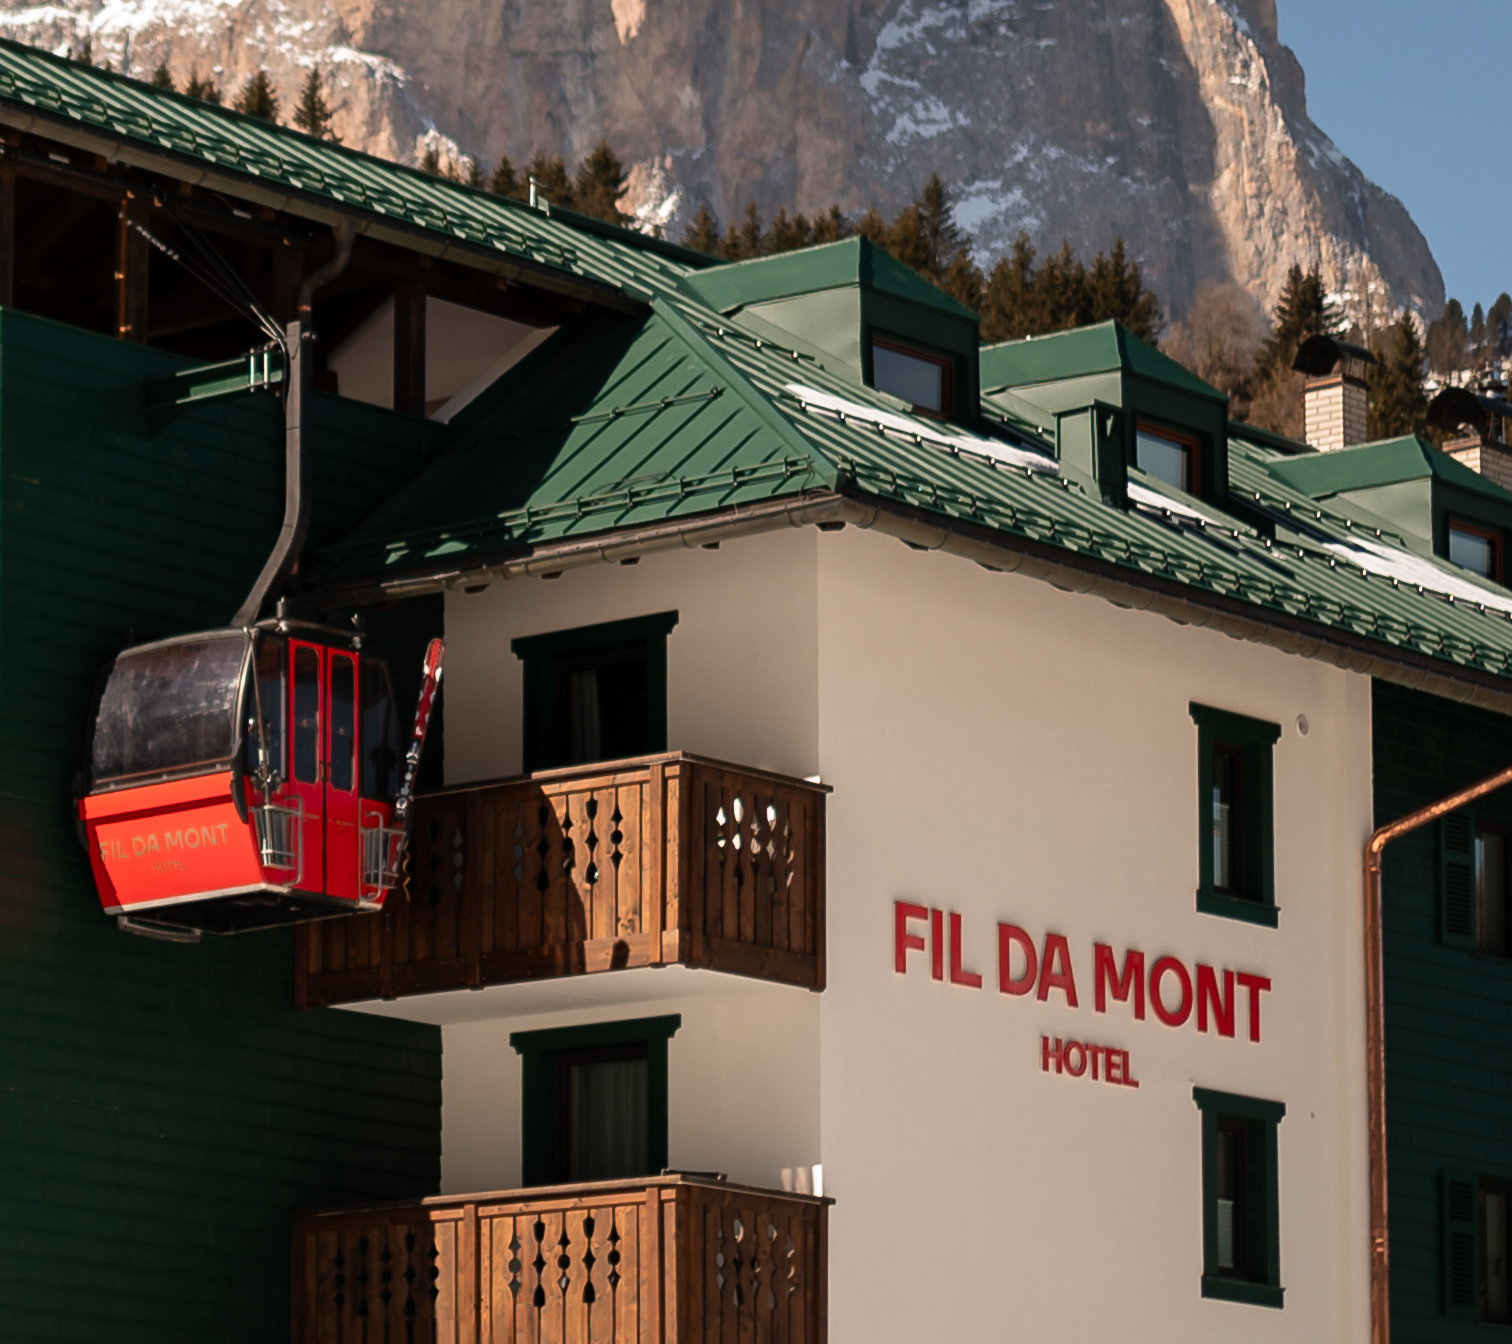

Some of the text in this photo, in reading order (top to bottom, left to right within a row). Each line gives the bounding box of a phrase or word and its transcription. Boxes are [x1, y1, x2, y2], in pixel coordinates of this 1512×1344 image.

[99, 823, 228, 862] FIL DA MONT
[151, 859, 187, 874] HOTEL
[894, 901, 1271, 1043] FIL DA MONT
[1040, 1035, 1139, 1088] HOTEL
